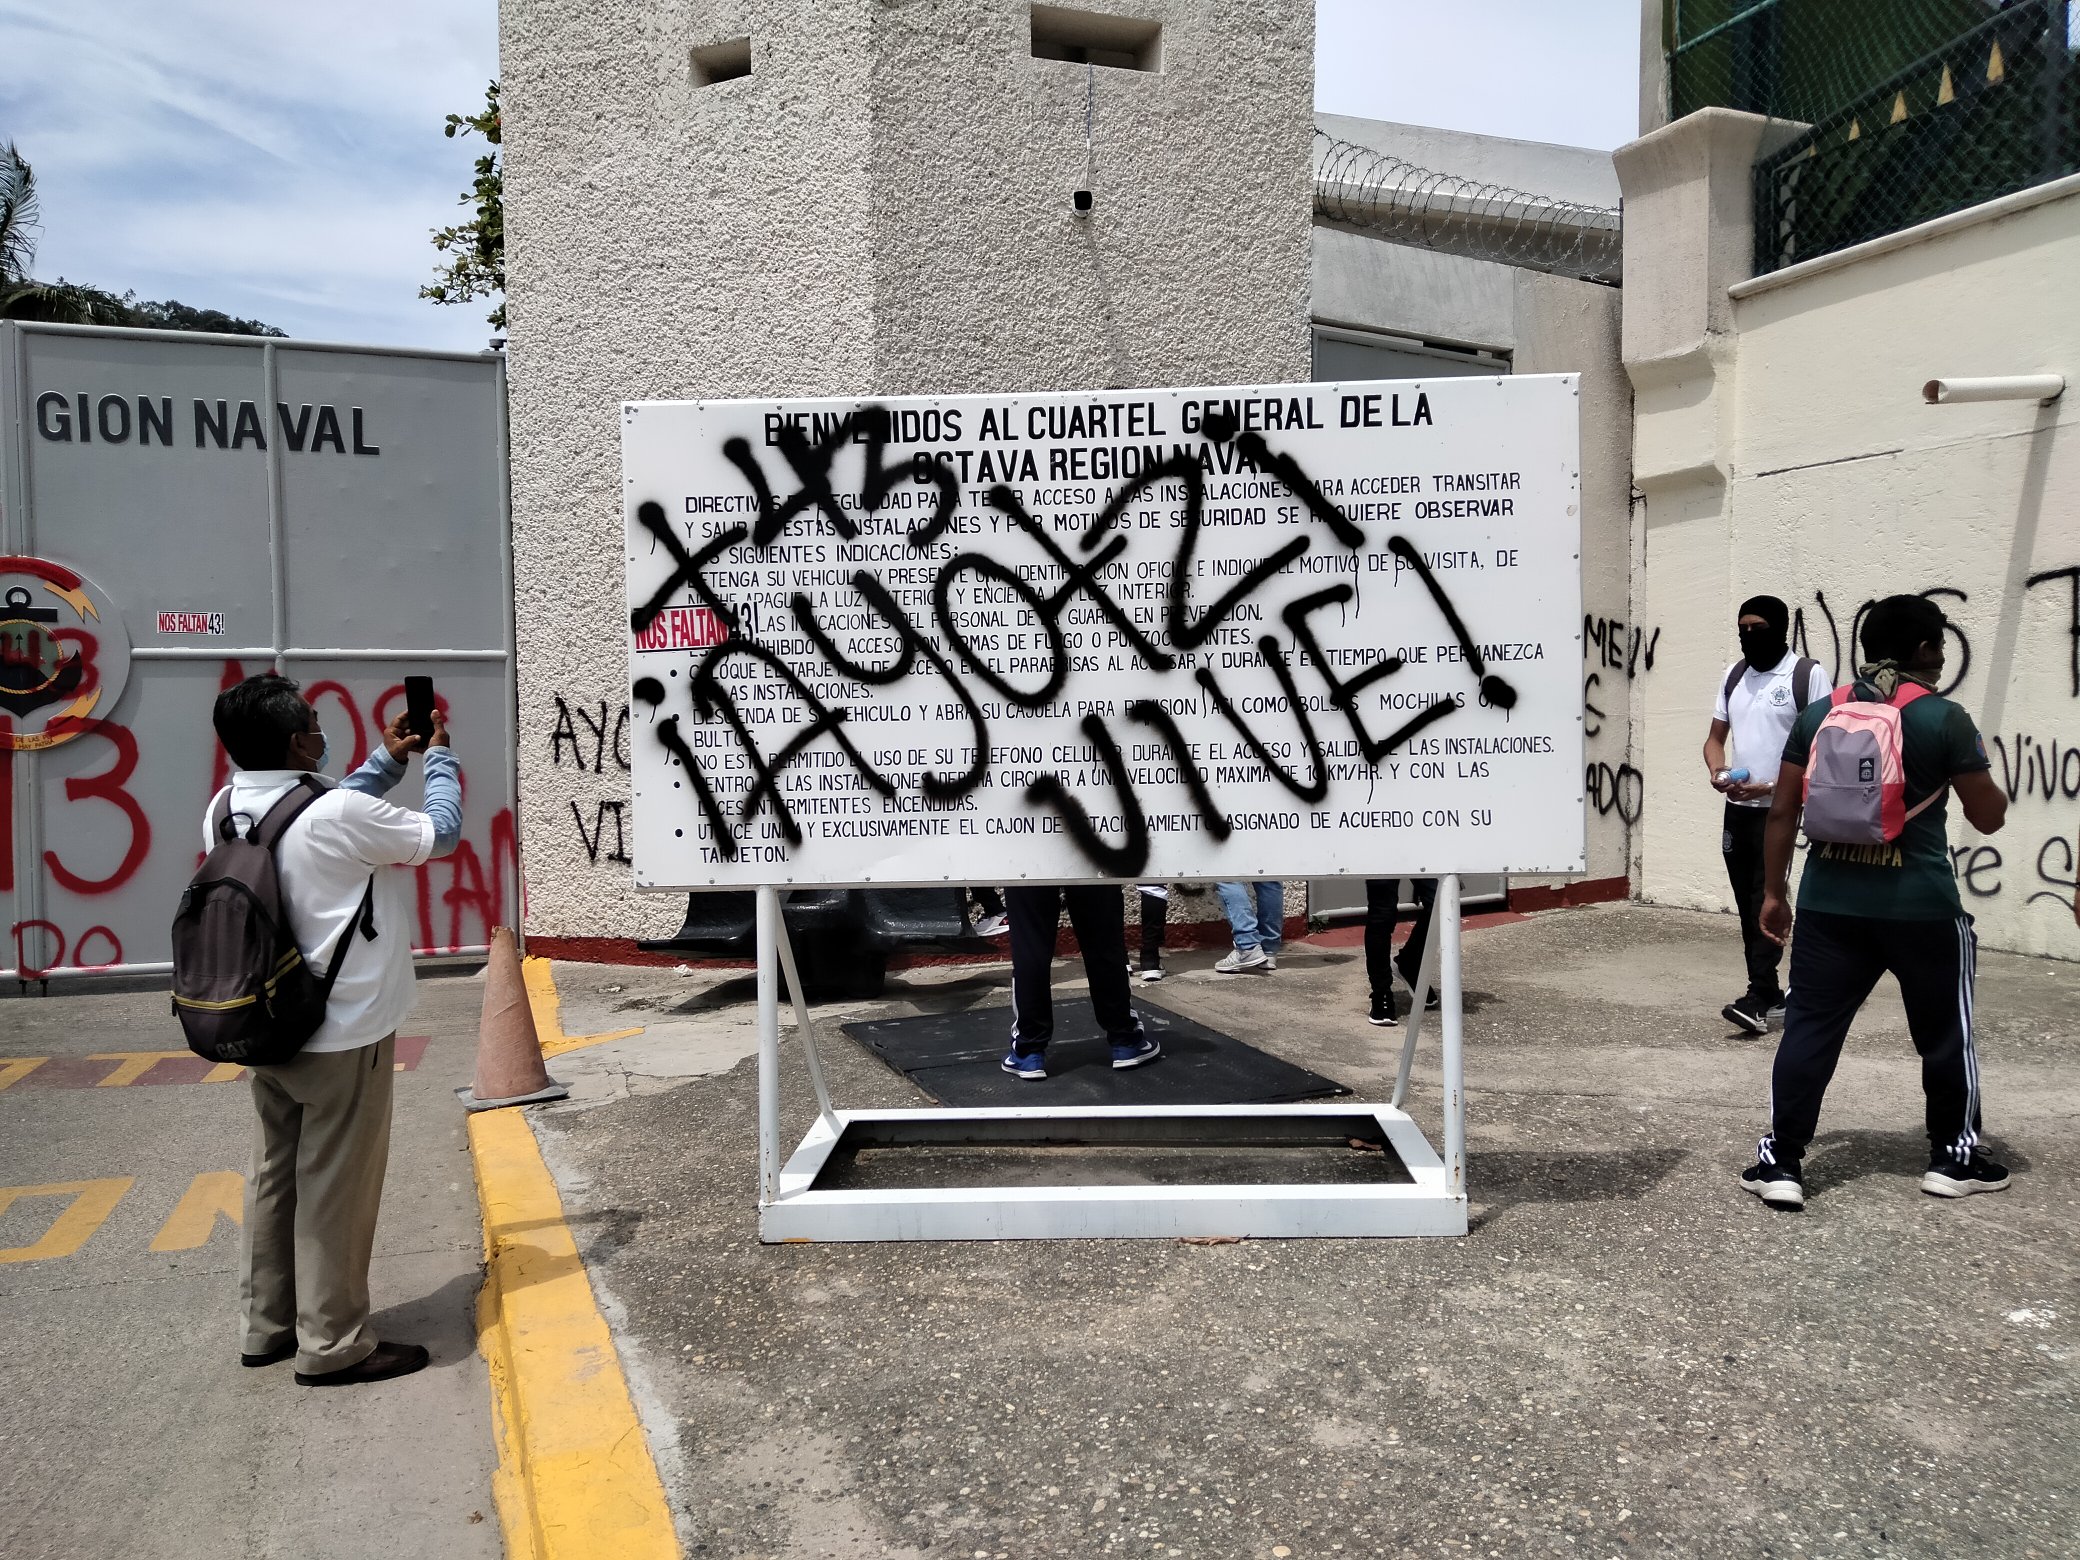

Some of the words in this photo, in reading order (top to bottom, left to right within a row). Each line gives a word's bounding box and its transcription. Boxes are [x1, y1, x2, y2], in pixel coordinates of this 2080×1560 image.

[36, 390, 174, 444] GION
[192, 397, 380, 456] NAVAL
[764, 409, 962, 447] BIENVEIDOS
[979, 407, 1018, 441] AL
[1027, 402, 1167, 440] CUARTEL
[1181, 397, 1324, 434] GENERAL
[1340, 395, 1382, 428] DE
[1391, 392, 1433, 427] LA
[1049, 445, 1163, 480] REGION
[685, 494, 782, 514] DIRECTIVS
[917, 489, 962, 508] PAA
[968, 488, 1024, 507] TER
[1033, 487, 1096, 506] ACCESO
[1104, 487, 1113, 504] A
[1160, 481, 1293, 502] INSALACIONES
[1306, 478, 1344, 497] ARA
[1350, 476, 1421, 495] ACCEDER
[1432, 472, 1521, 492] TRANSITAR
[685, 520, 695, 539] Y
[783, 519, 836, 537] ESTAS
[989, 515, 1000, 533] Y
[1054, 512, 1132, 532] MOTIOS
[1139, 511, 1161, 528] DE
[1170, 507, 1266, 527] SEURIDAD
[1277, 506, 1300, 524] SE
[1415, 498, 1514, 519] OBSERVAR
[729, 545, 826, 564] SIGUIENTES
[836, 543, 959, 562] INDICACIONES:
[767, 569, 786, 587] SU
[873, 568, 883, 584] Y
[888, 566, 968, 585] PRESENE
[1197, 559, 1205, 577] E
[1300, 555, 1360, 574] MOTIVO
[1368, 553, 1389, 572] DE
[1424, 550, 1485, 571] VISITA,
[1496, 549, 1519, 568] DE
[810, 591, 829, 608] LA
[835, 590, 862, 608] LUZ
[955, 588, 965, 604] Y
[973, 586, 1045, 604] ENCIENA
[158, 613, 176, 632] NOS
[178, 614, 208, 633] FALTAN
[208, 613, 225, 635] 43!
[670, 606, 730, 649] FALTAN
[791, 611, 891, 632] INICACIONES
[931, 610, 1009, 629] PRSONAL
[1017, 609, 1036, 626] DE
[1134, 606, 1154, 624] EN
[847, 637, 904, 654] ACCESO
[1007, 633, 1026, 650] DE
[1035, 632, 1083, 650] FUGO
[1091, 631, 1101, 649] O
[689, 662, 757, 680] CLOQUE
[764, 661, 781, 679] EL
[871, 658, 891, 675] DE
[988, 657, 1006, 675] EL
[1107, 654, 1125, 671] AL
[1204, 652, 1214, 669] Y
[1326, 648, 1387, 666] TIEMPO
[1396, 646, 1428, 664] QUE
[782, 706, 802, 723] DE
[919, 705, 929, 721] Y
[981, 702, 1001, 721] SU
[1005, 701, 1072, 720] CAJUELA
[1077, 700, 1115, 718] PARA
[1241, 696, 1288, 714] COMO
[1299, 694, 1359, 712] BOLSS
[694, 753, 718, 770] NO
[724, 753, 757, 770] EST
[873, 749, 902, 766] USO
[907, 749, 928, 765] DE
[934, 748, 953, 765] SU
[960, 746, 1042, 765] TEEFONO
[1209, 742, 1227, 760] EL
[1299, 740, 1310, 759] Y
[1409, 738, 1440, 756] LAS
[1445, 736, 1555, 755] INSTALACIONES.
[700, 776, 755, 793] ENTRO
[786, 774, 812, 792] LAS
[1000, 769, 1071, 788] CIRCUAR
[1076, 769, 1086, 788] A
[1130, 767, 1209, 786] VELOCIDD
[1216, 765, 1271, 783] MAXIMA
[1327, 763, 1383, 782] KM/HR.
[1390, 762, 1400, 780] Y
[1409, 761, 1445, 779] CON
[1457, 760, 1490, 779] LAS
[697, 800, 744, 817] LCES
[753, 797, 871, 816] INTRMITENTES
[882, 795, 978, 815] ENCENDIDAS.
[697, 822, 753, 841] UTICE
[807, 821, 815, 839] Y
[822, 818, 950, 838] EXCLUSIVAMENTE
[959, 818, 979, 836] EL
[985, 816, 1035, 835] CAJON
[1042, 816, 1063, 834] DE
[1225, 811, 1300, 831] ASIGNADO
[1311, 810, 1331, 830] DE
[1338, 809, 1414, 829] ACUERDO
[1422, 809, 1460, 828] CON
[1470, 808, 1492, 827] SU
[699, 845, 790, 864] TARJETON.
